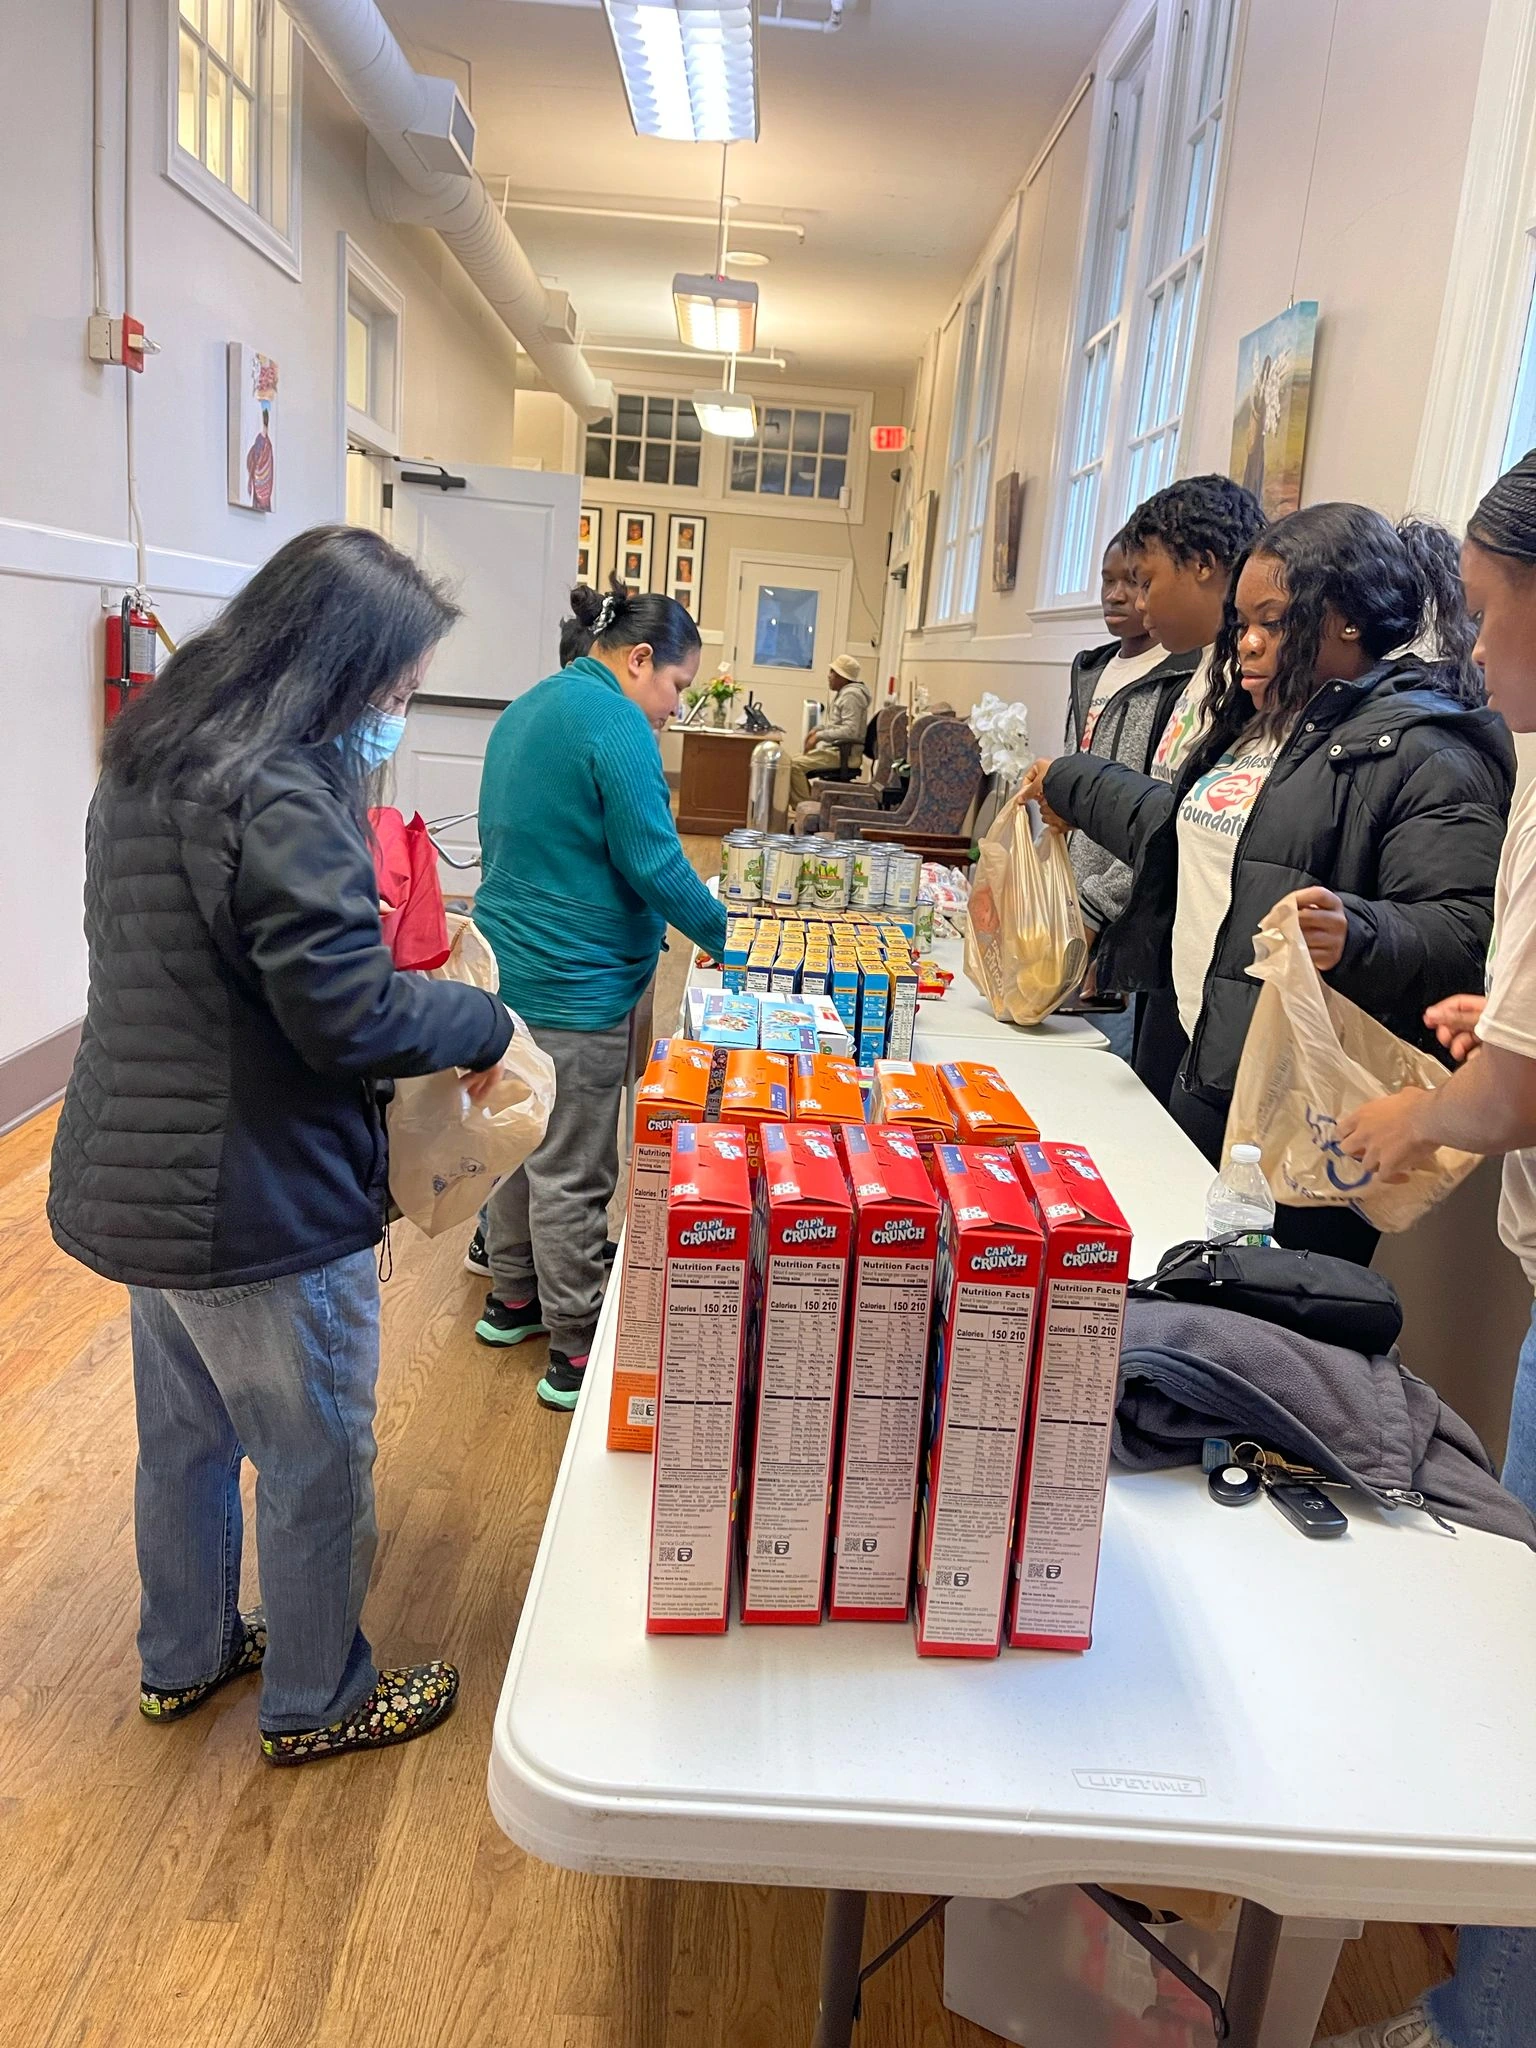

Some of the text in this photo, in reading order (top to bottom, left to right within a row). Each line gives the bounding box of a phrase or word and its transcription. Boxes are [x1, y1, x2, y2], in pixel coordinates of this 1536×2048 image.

[638, 1148, 670, 1158] Nutrition
[634, 1188, 656, 1197] Calories
[680, 1228, 736, 1245] CRUNCH
[782, 1226, 836, 1243] CRUNCH
[872, 1227, 926, 1244] CRUNCH
[971, 1254, 1027, 1270] CRUNCH
[1062, 1250, 1118, 1267] CRUNCH
[672, 1262, 740, 1272] Nutrition Facts
[773, 1260, 840, 1270] Nutrition Facts
[863, 1261, 902, 1270] Nutrition
[962, 1288, 1030, 1299] Nutrition Facts
[1053, 1284, 1120, 1295] Nutrition Facts
[669, 1304, 738, 1313] Calories 150 210
[770, 1301, 837, 1310] Calories 150 210
[860, 1302, 926, 1311] Calories 150 210
[957, 1329, 1025, 1340] Calories 150 210
[1049, 1325, 1116, 1336] Calories 150 210
[1088, 1775, 1192, 1793] LIFETIME
